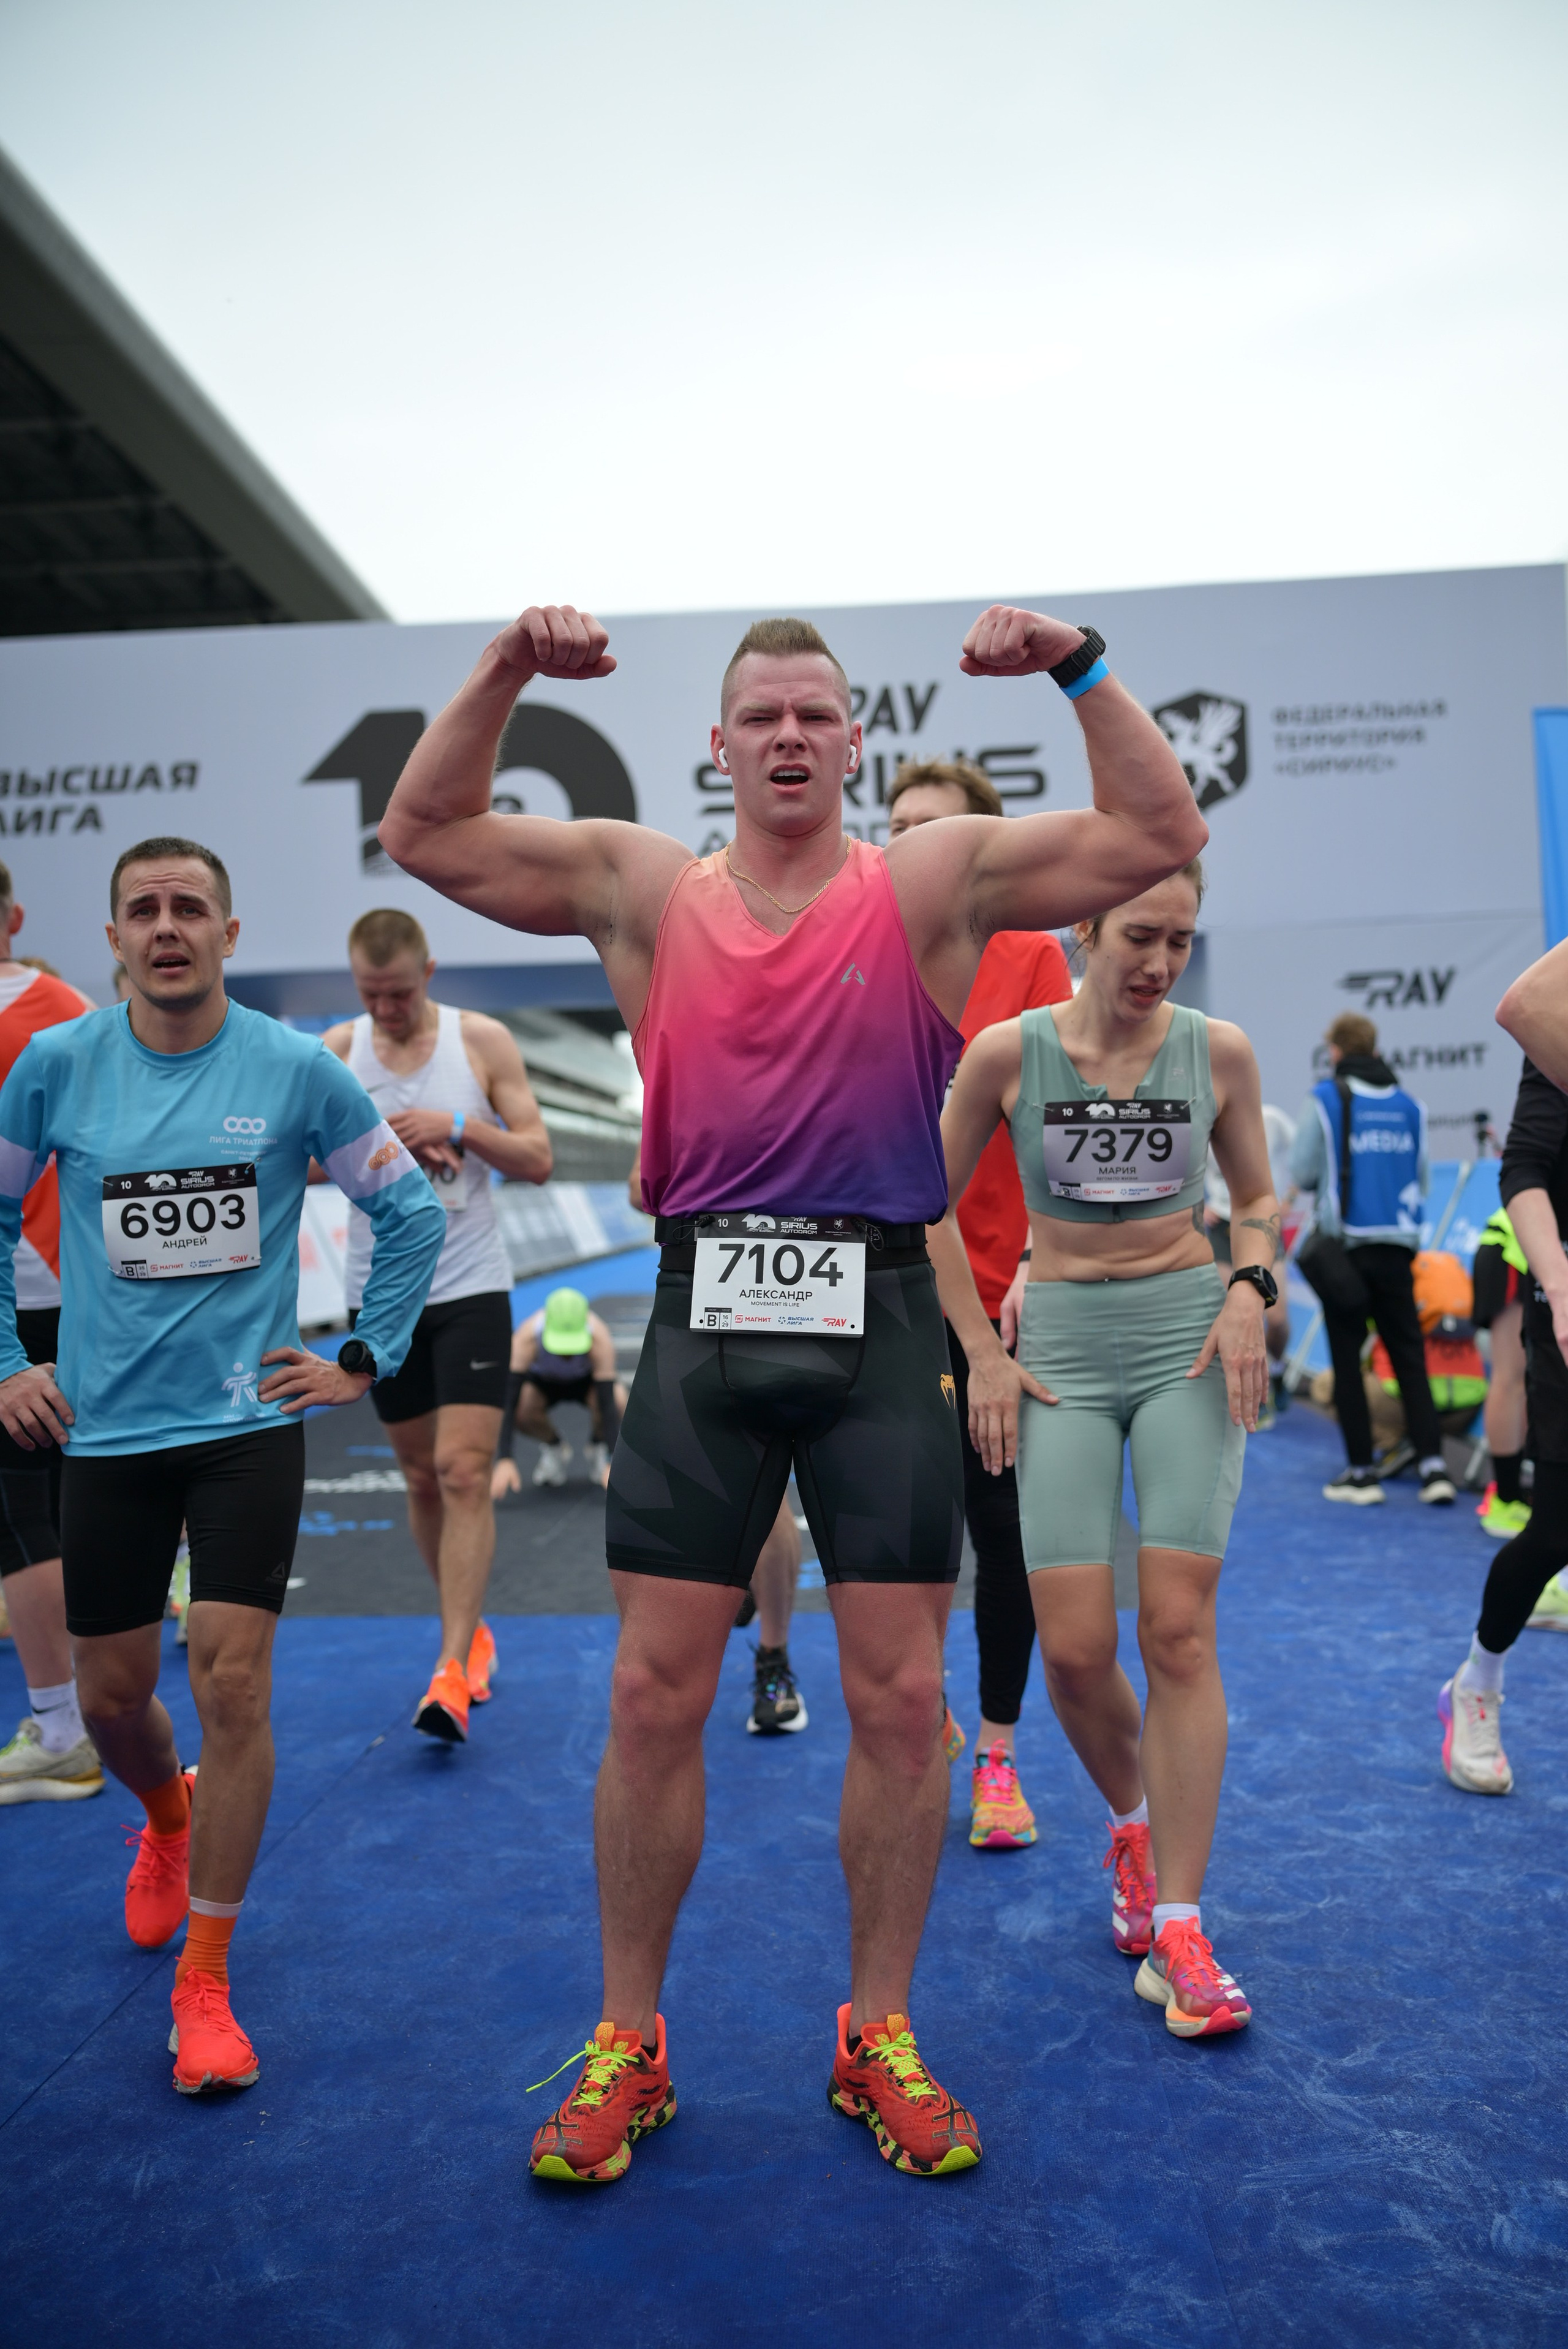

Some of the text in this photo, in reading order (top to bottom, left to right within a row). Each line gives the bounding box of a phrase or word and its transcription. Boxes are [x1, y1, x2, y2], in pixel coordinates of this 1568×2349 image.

[1379, 1043, 1487, 1070] АГНИТ
[1062, 1108, 1073, 1116] 10
[209, 1136, 277, 1146] ЛИГА ТРИАТЛОНА
[1065, 1128, 1172, 1162] 7379
[121, 1181, 132, 1190] 10
[181, 1176, 215, 1185] SIRIUS
[121, 1194, 246, 1239] 6903
[717, 1219, 728, 1227] 10
[162, 1236, 207, 1249] АНДРЕЙ
[718, 1243, 843, 1287] 7104
[739, 1289, 813, 1301] АЛЕКСАНДР
[821, 1318, 847, 1327] RAY
